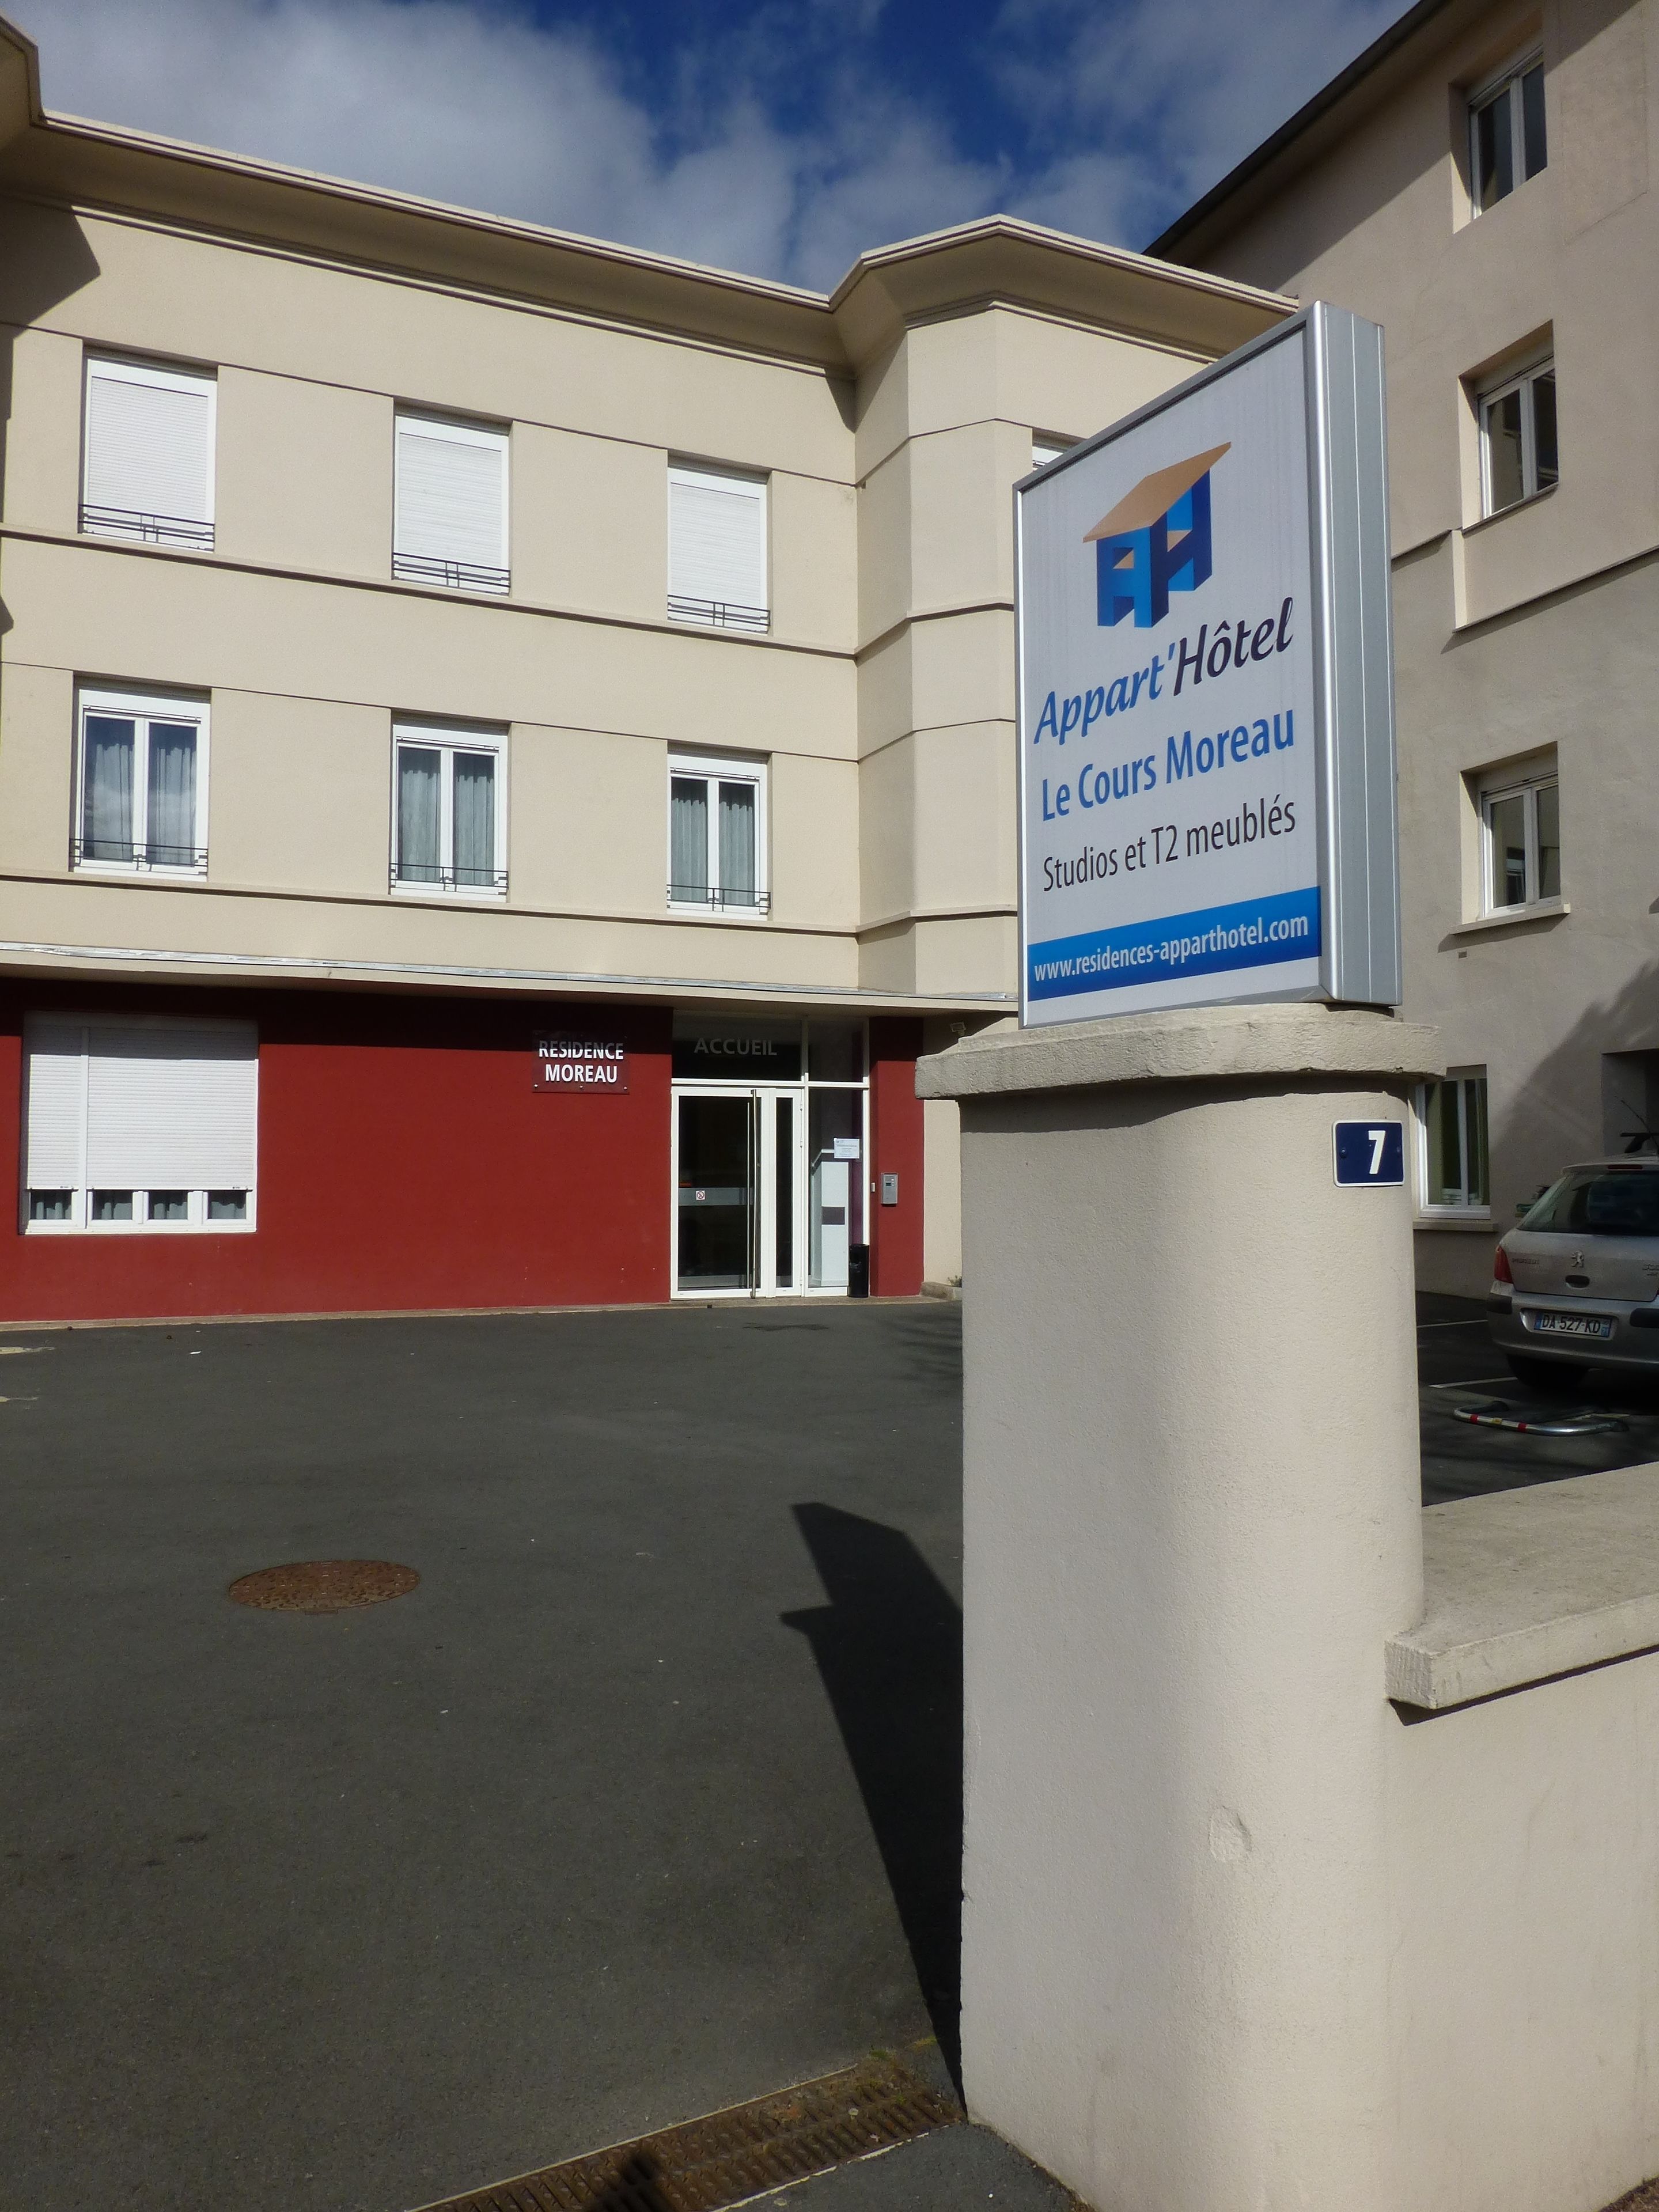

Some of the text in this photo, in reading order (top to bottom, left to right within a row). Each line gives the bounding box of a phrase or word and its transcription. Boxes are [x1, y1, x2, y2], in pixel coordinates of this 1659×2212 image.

[1033, 597, 1294, 745] Appart'Hôtel
[1042, 709, 1294, 821] Le Cours Moreau
[1043, 794, 1296, 892] Studios et T2 meublés
[1034, 915, 1309, 982] www.residences-apparthotel.com
[539, 1040, 624, 1060] RESIDENCE
[546, 1063, 618, 1084] MOREAU
[694, 1037, 778, 1056] ACCUEIL
[1368, 1130, 1386, 1175] 7
